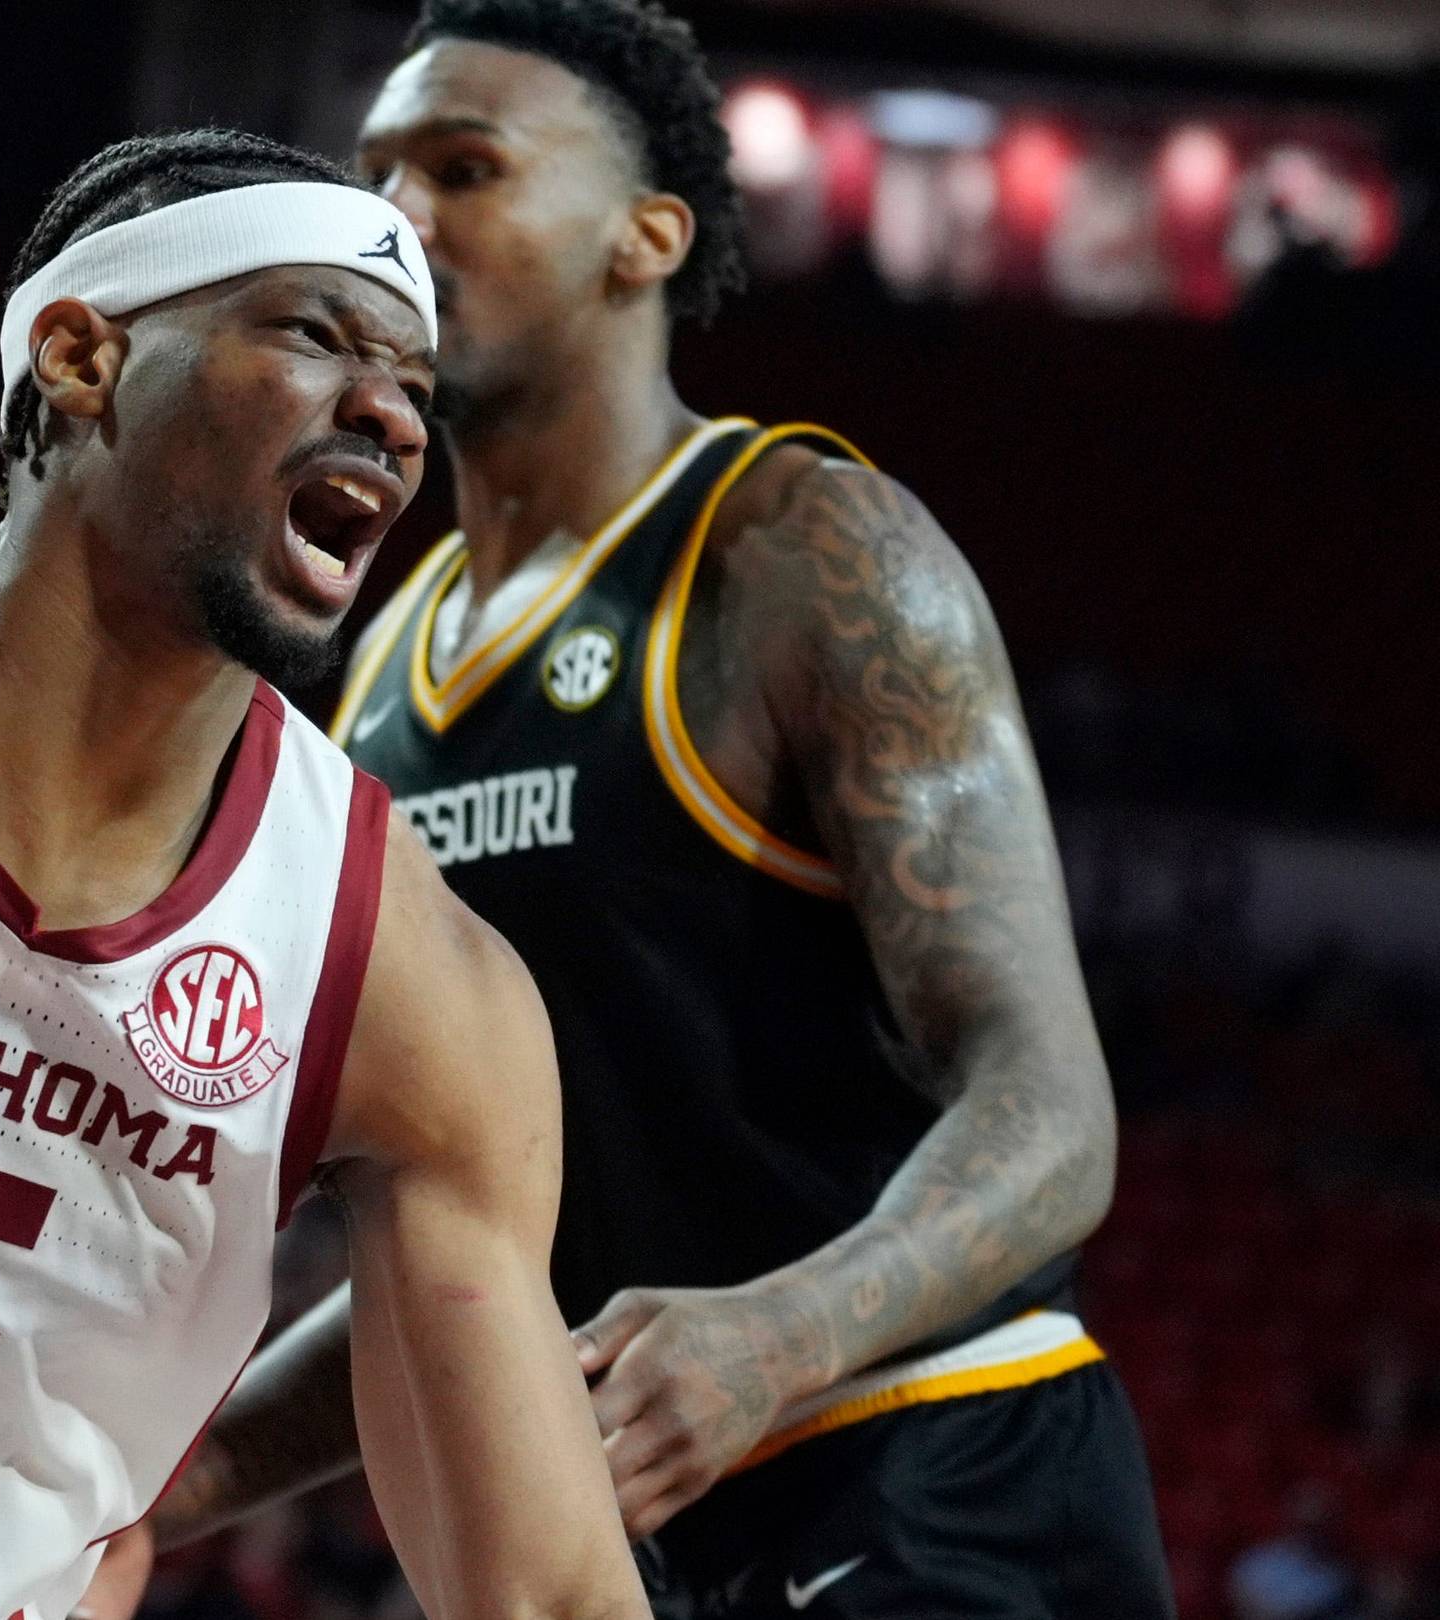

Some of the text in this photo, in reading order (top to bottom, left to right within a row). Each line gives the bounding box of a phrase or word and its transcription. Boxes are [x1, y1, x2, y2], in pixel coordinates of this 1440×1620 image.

[552, 633, 612, 703] SEC
[392, 765, 577, 867] SSOURI
[159, 951, 258, 1064] SEC
[139, 1038, 258, 1102] GRADUATE
